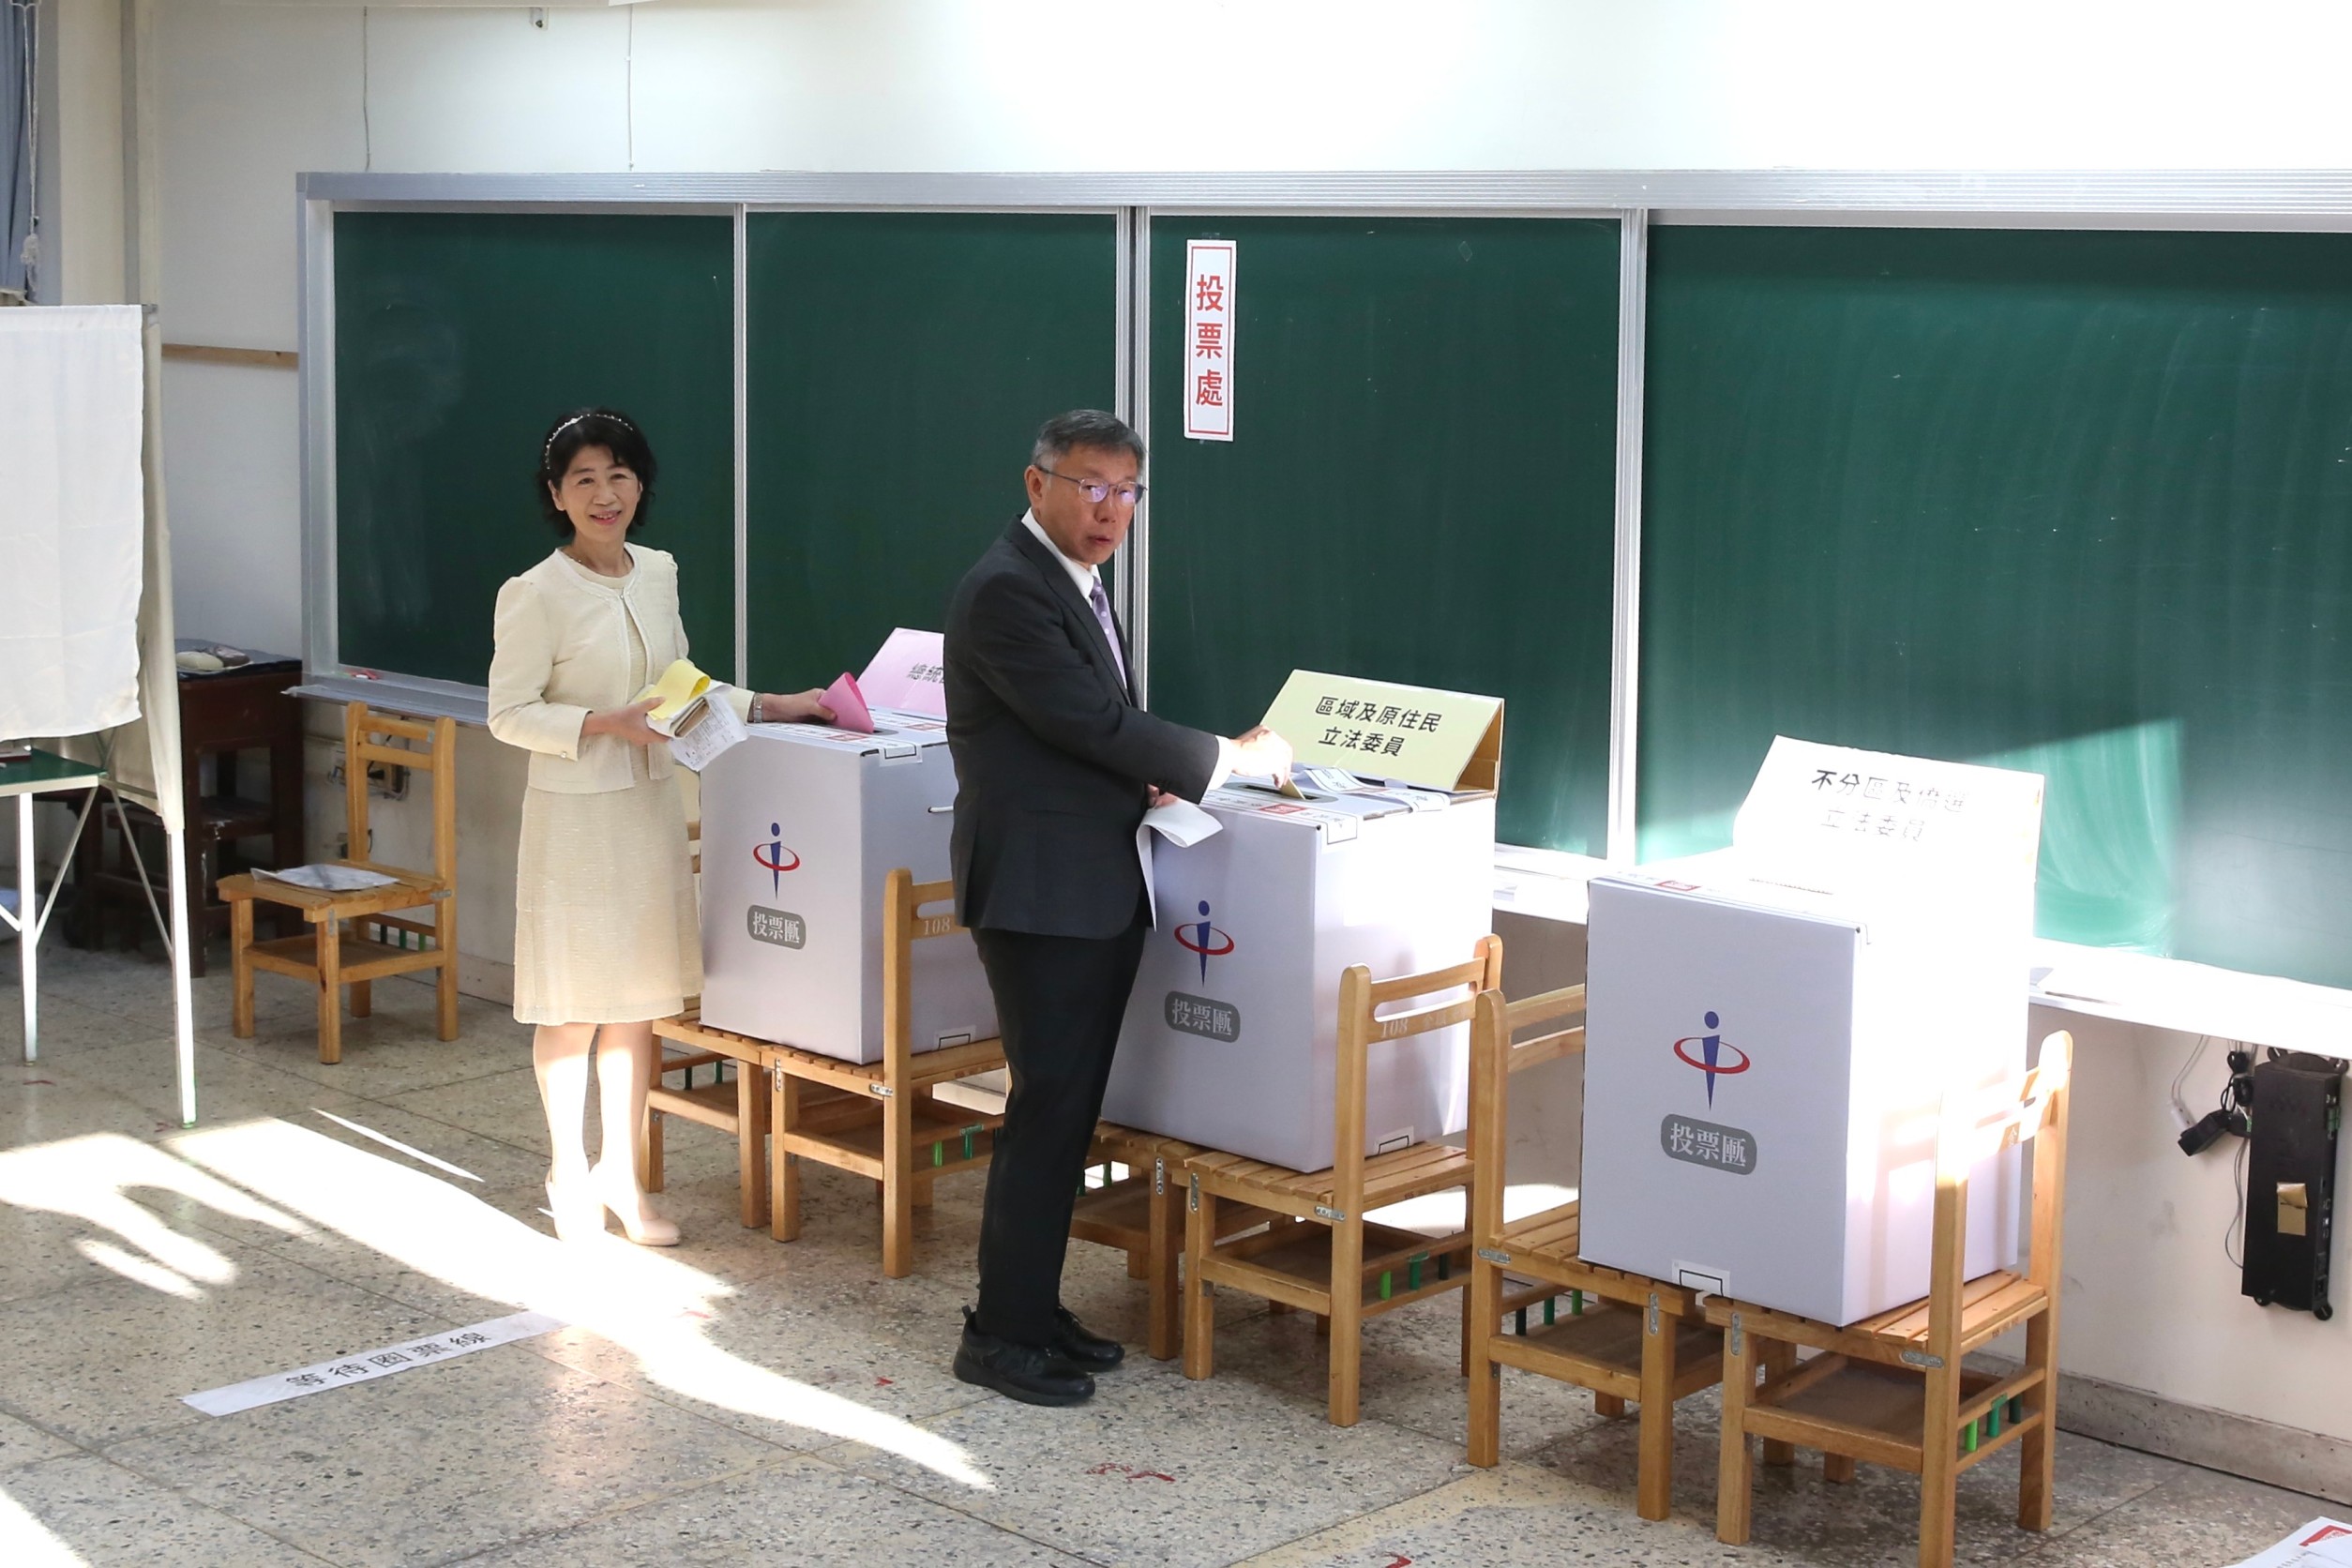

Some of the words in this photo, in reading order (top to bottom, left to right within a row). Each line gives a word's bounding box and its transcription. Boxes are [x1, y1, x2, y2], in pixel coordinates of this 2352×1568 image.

[1196, 274, 1224, 406] 投票處
[1315, 696, 1442, 732] 區域及原住民
[1318, 726, 1405, 757] 立法委員
[924, 915, 951, 936] 108
[1669, 1122, 1746, 1167] 投票匭
[285, 1331, 491, 1388] 等待圈票線
